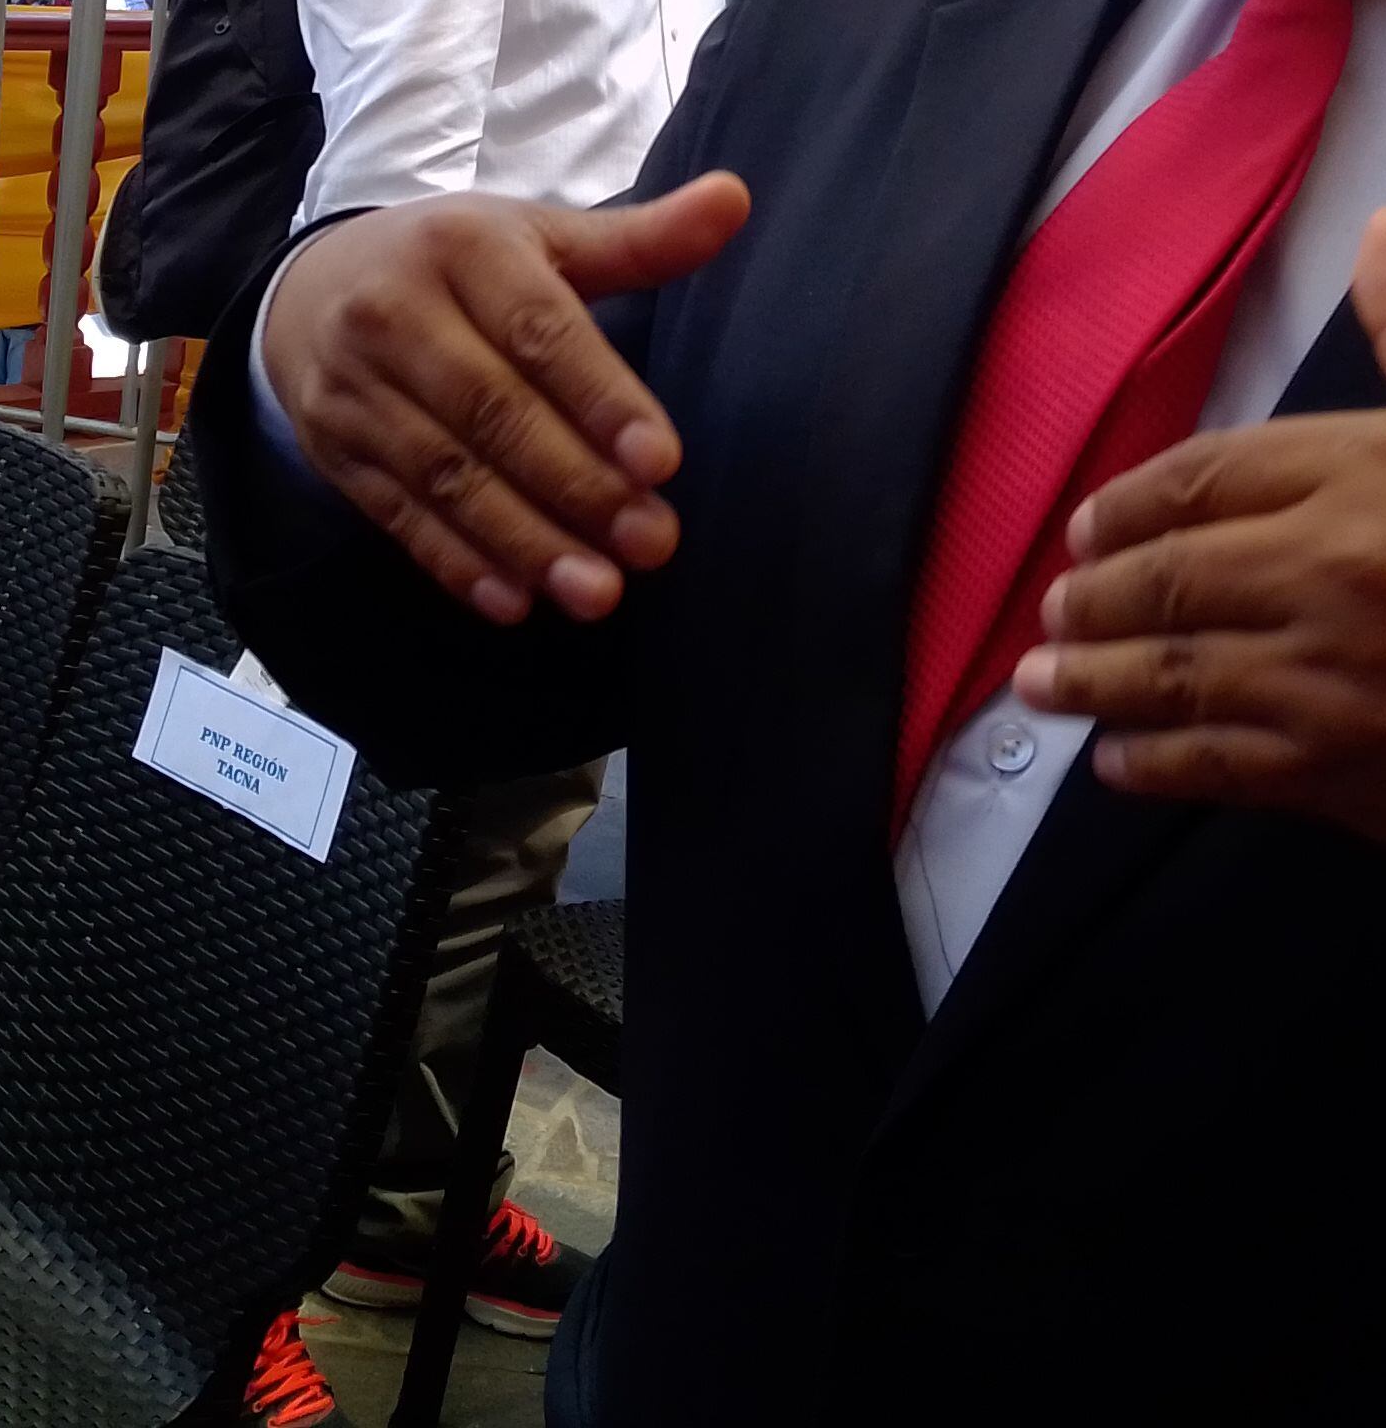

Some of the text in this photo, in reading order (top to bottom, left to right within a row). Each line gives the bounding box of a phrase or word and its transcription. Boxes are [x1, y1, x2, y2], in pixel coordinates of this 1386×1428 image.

[199, 726, 288, 783] PNP REGIÓN
[216, 758, 260, 795] TACNA
